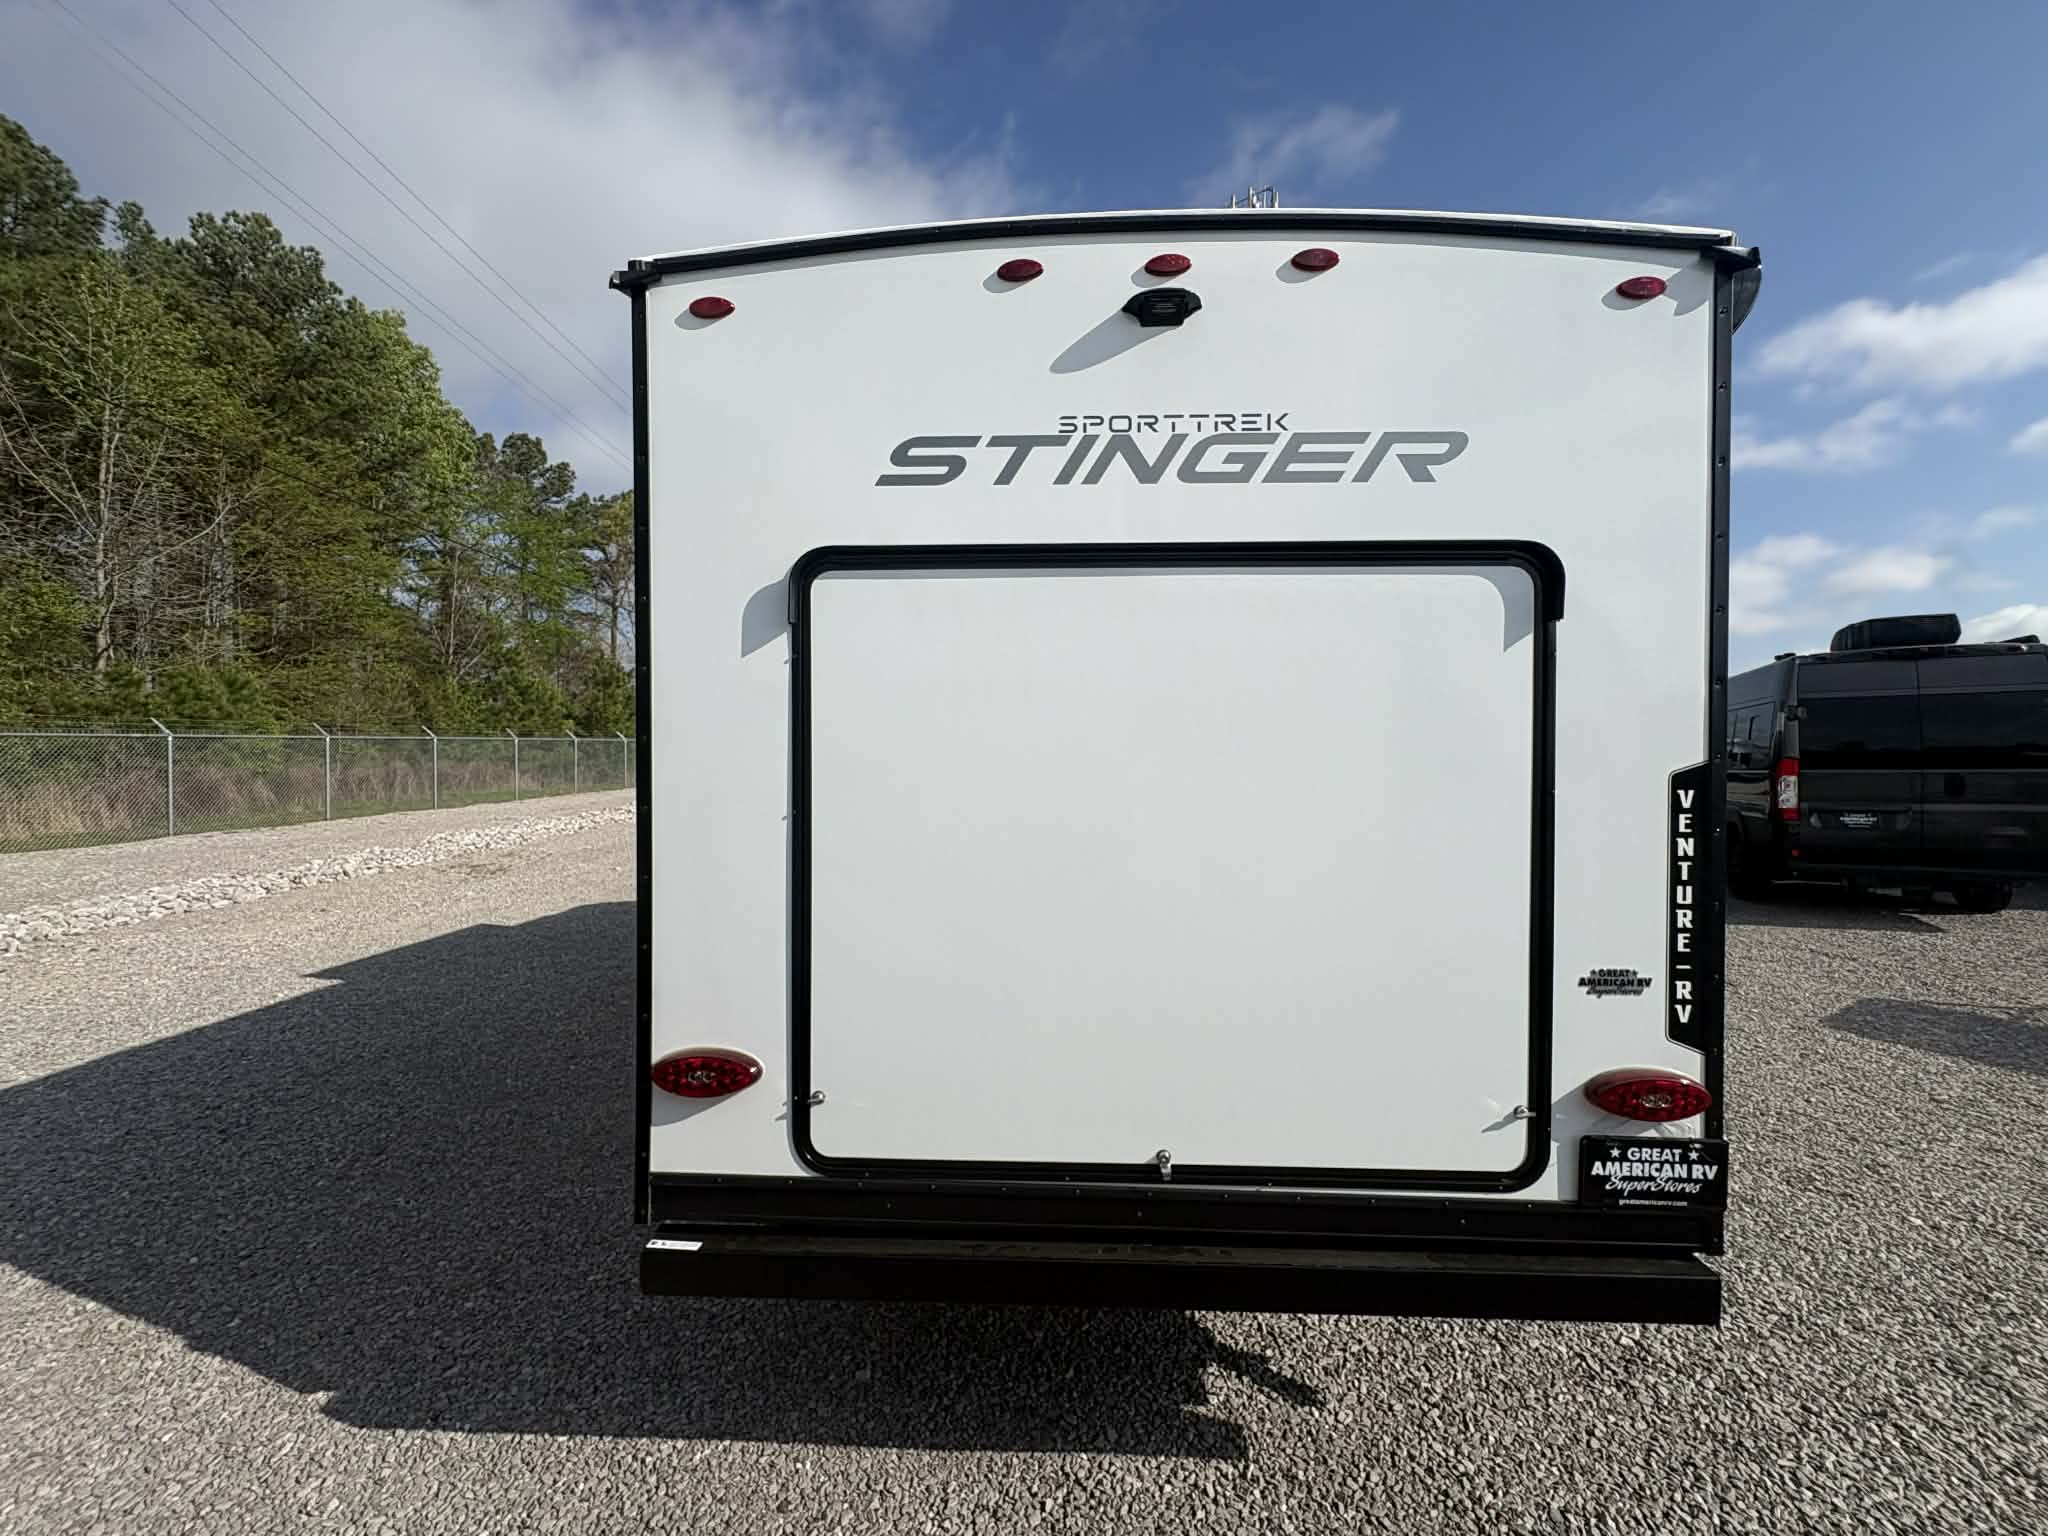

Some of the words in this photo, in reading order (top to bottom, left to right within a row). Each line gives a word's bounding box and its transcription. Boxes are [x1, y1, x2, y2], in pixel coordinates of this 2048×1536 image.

[1058, 413, 1289, 434] SPORTTREK
[874, 431, 1470, 486] STINGER
[1578, 977, 1635, 988] AMERICAN
[1637, 978, 1652, 987] RV
[1598, 969, 1631, 978] GREAT
[1627, 1147, 1682, 1162] GREAT
[1591, 1161, 1688, 1178] AMERICAN
[1692, 1164, 1718, 1179] RV
[1605, 1174, 1701, 1196] SuperStores
